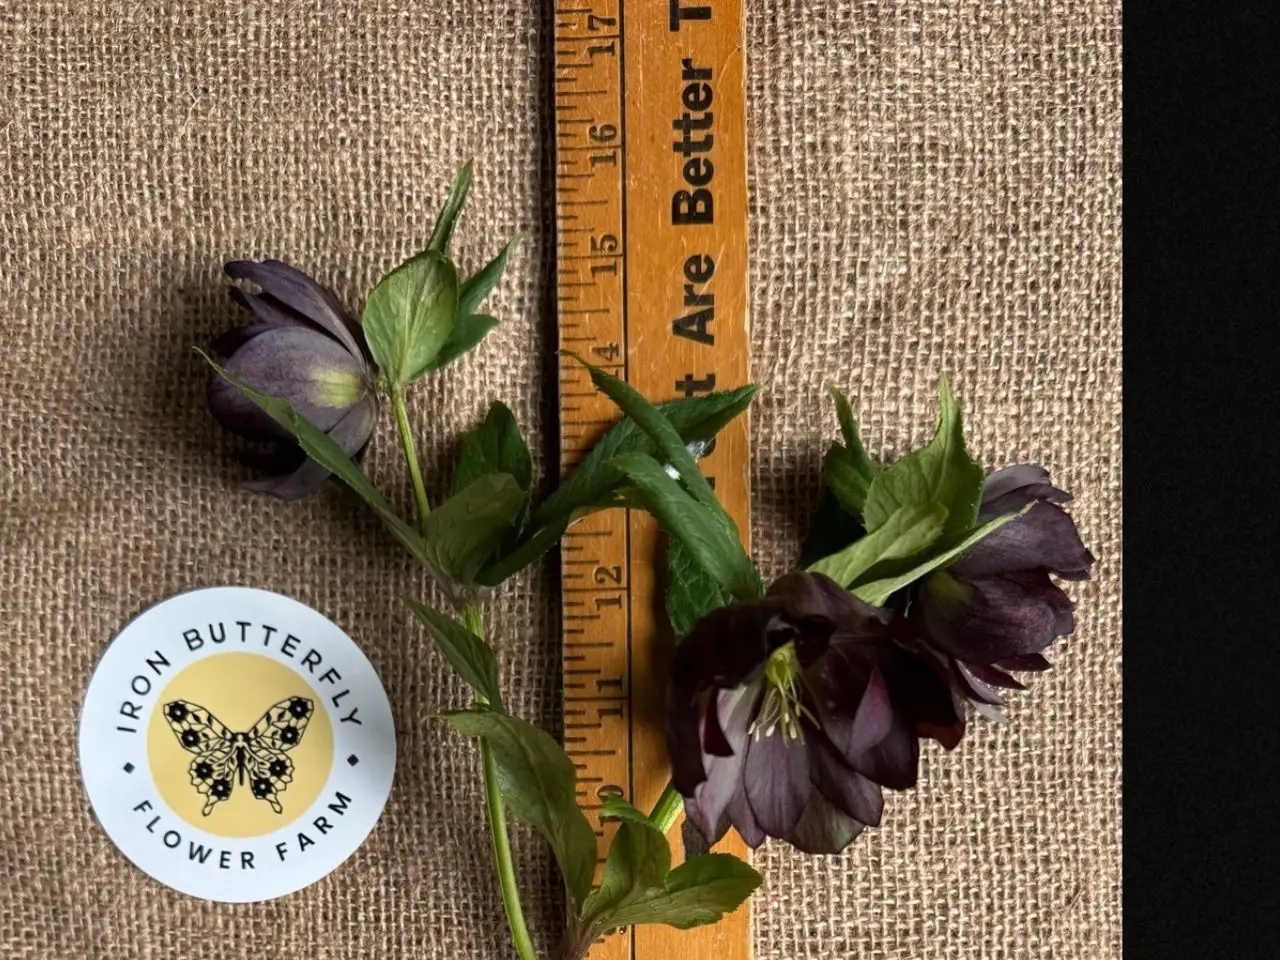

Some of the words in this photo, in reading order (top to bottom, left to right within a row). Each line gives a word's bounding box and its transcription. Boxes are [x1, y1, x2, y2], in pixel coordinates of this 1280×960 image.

[587, 14, 617, 58] 17
[588, 124, 618, 168] 16
[671, 58, 715, 225] Better
[590, 234, 619, 277] 15
[672, 253, 716, 345] Are
[595, 565, 623, 610] 12
[116, 650, 171, 733] IRON
[183, 620, 363, 726] BUTTERFLY
[596, 676, 624, 720] 11
[133, 800, 255, 870] FLOWER
[275, 791, 352, 862] FARM
